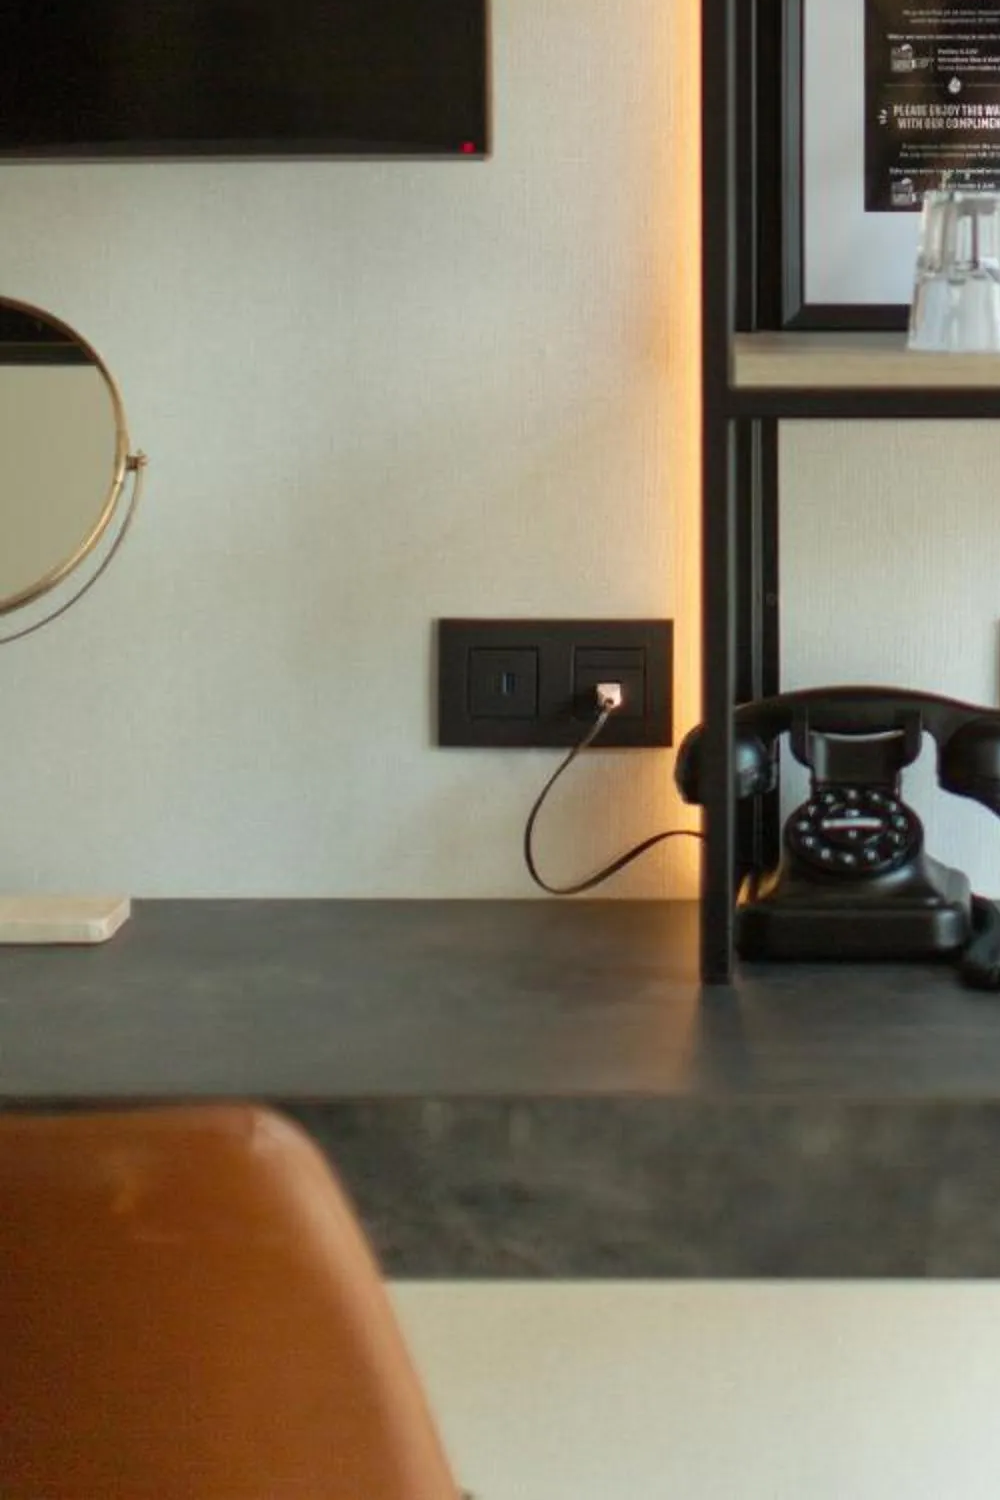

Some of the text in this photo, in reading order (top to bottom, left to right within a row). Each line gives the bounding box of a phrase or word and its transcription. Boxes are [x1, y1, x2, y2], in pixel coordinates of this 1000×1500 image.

[893, 103, 928, 116] PLEASE
[929, 103, 960, 116] ENJOY
[961, 103, 983, 116] THIS
[898, 117, 922, 129] WITH
